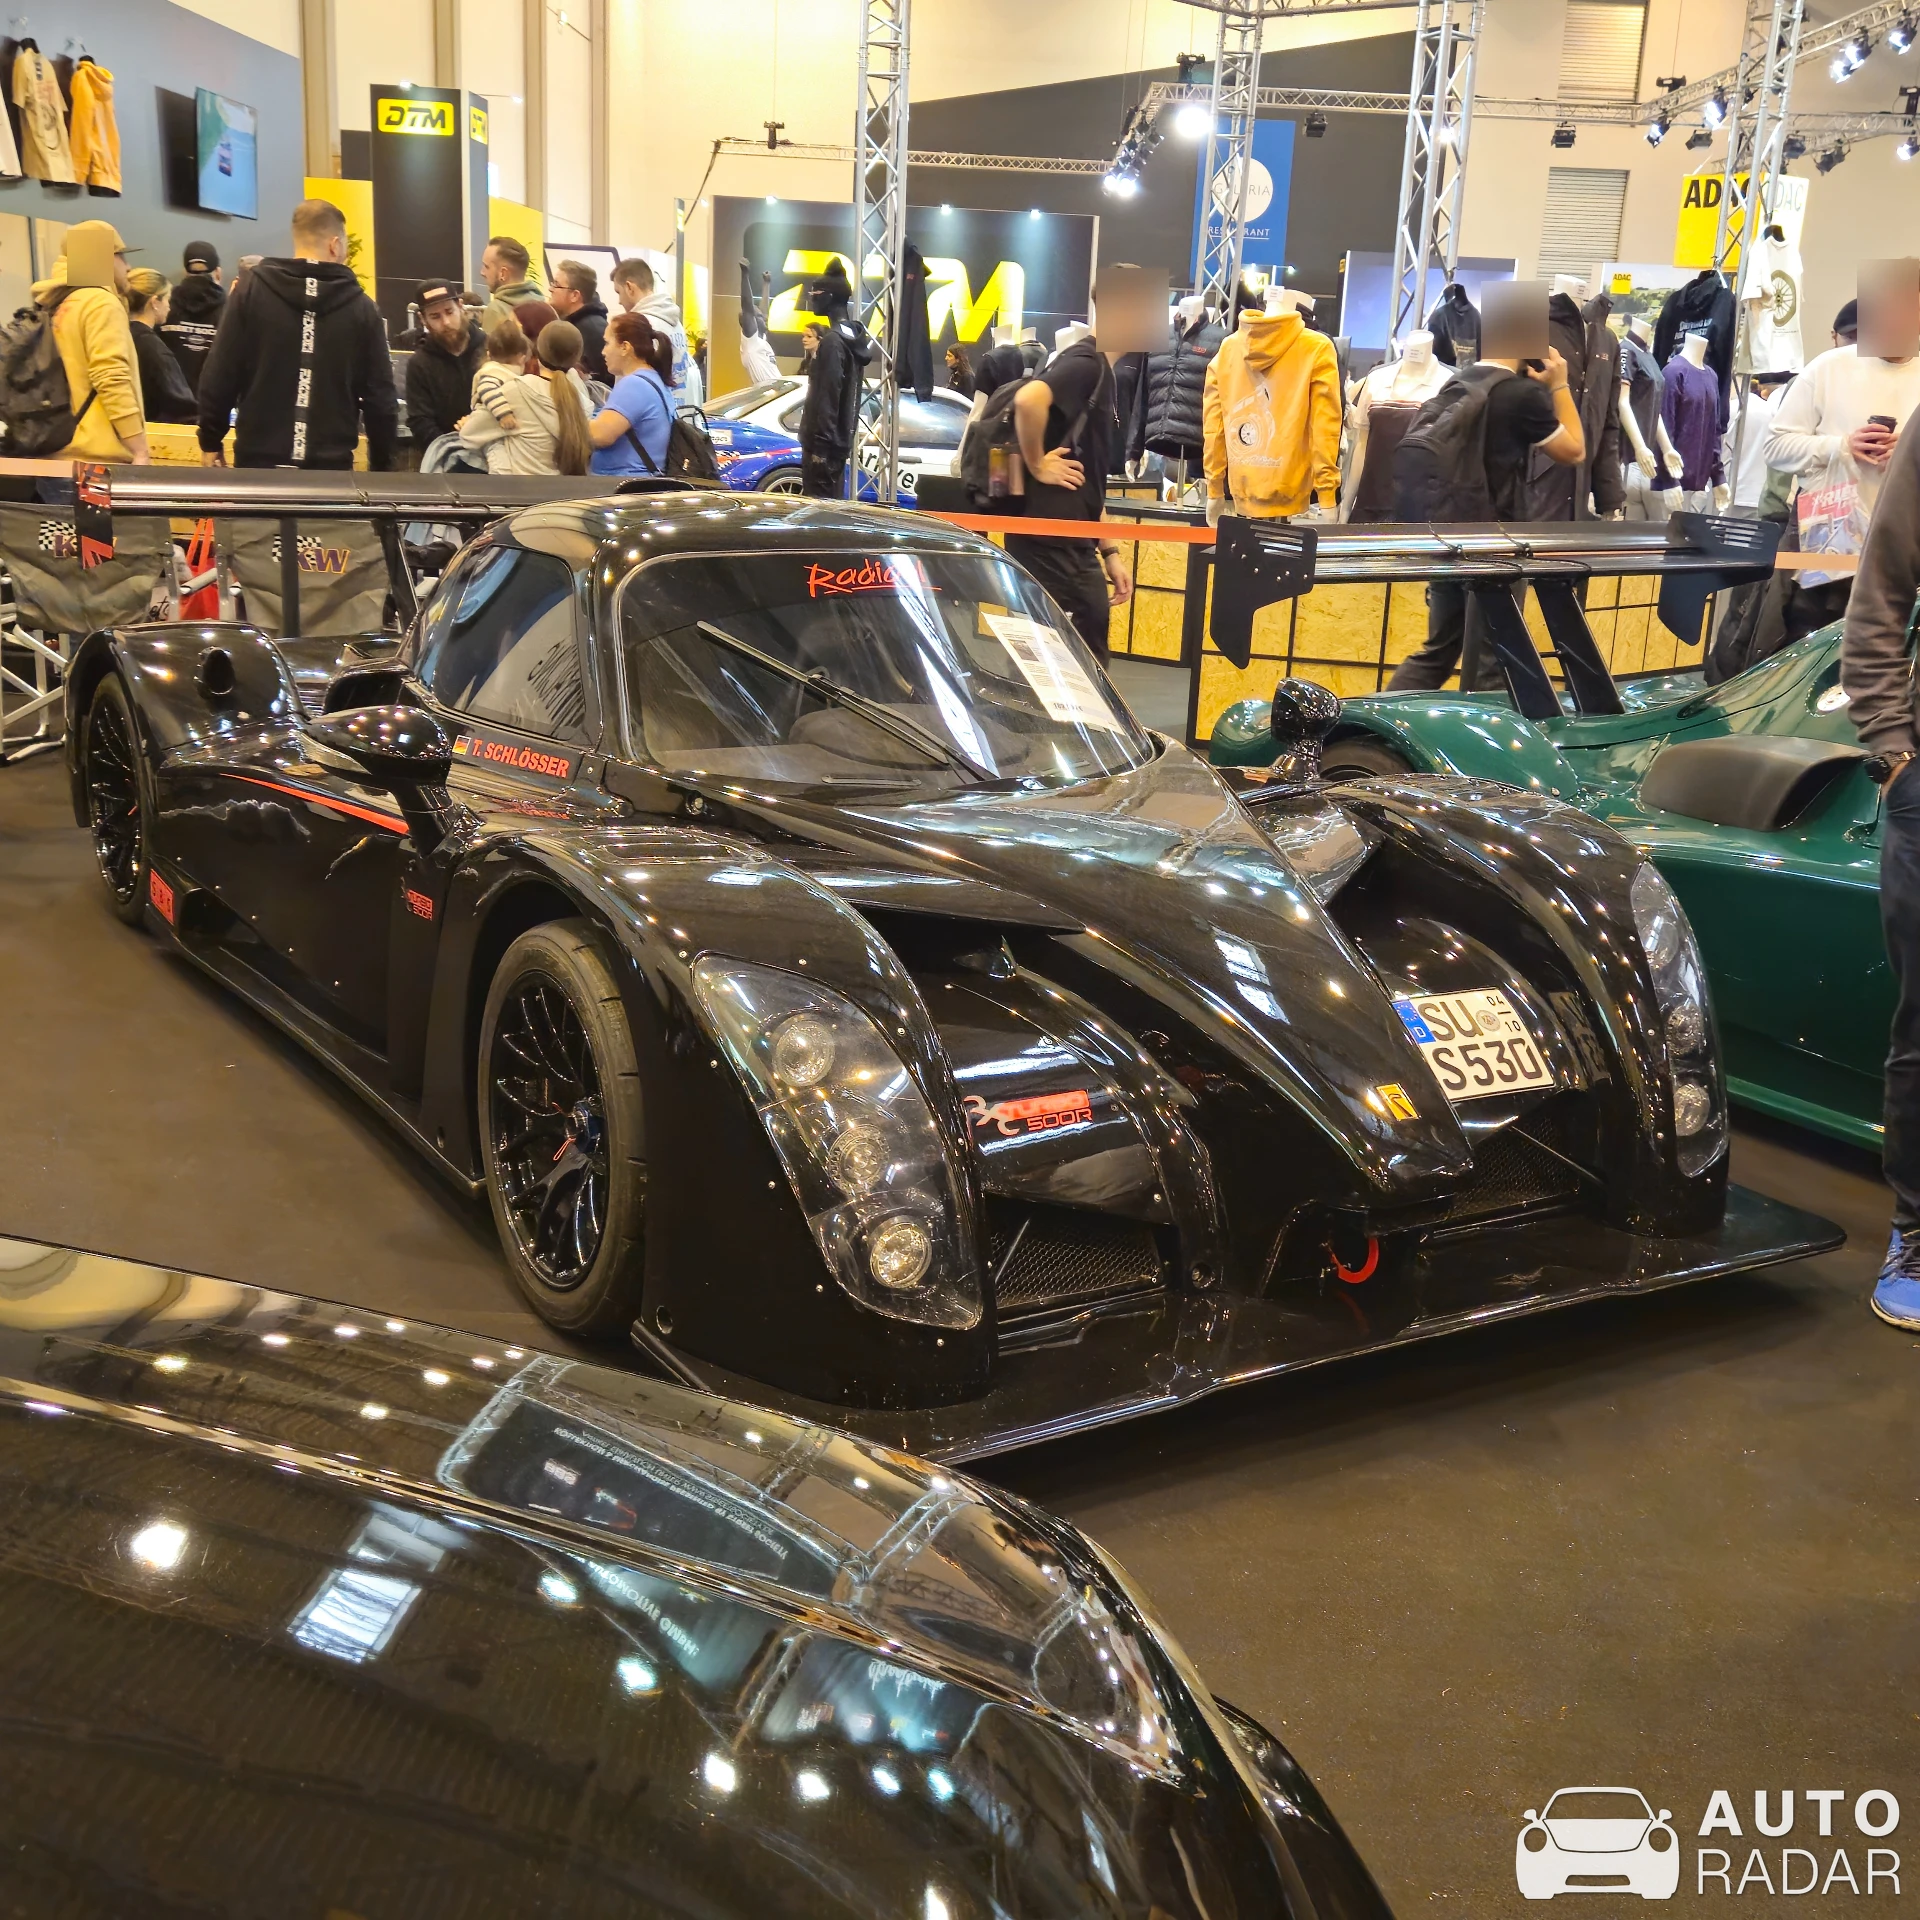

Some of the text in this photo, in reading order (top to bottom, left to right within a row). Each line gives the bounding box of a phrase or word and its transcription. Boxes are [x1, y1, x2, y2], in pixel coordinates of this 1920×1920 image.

[385, 105, 446, 129] DTM
[1214, 183, 1271, 196] GLRIA
[1208, 226, 1271, 237] RESRANT
[768, 249, 1025, 345] DTM
[804, 558, 928, 597] Radicl
[472, 738, 570, 778] T. SCHLÖSSER
[1414, 1021, 1521, 1038] D 10
[1418, 996, 1505, 1041] SU 04
[1432, 1038, 1543, 1091] S530
[1027, 1108, 1093, 1131] 500R
